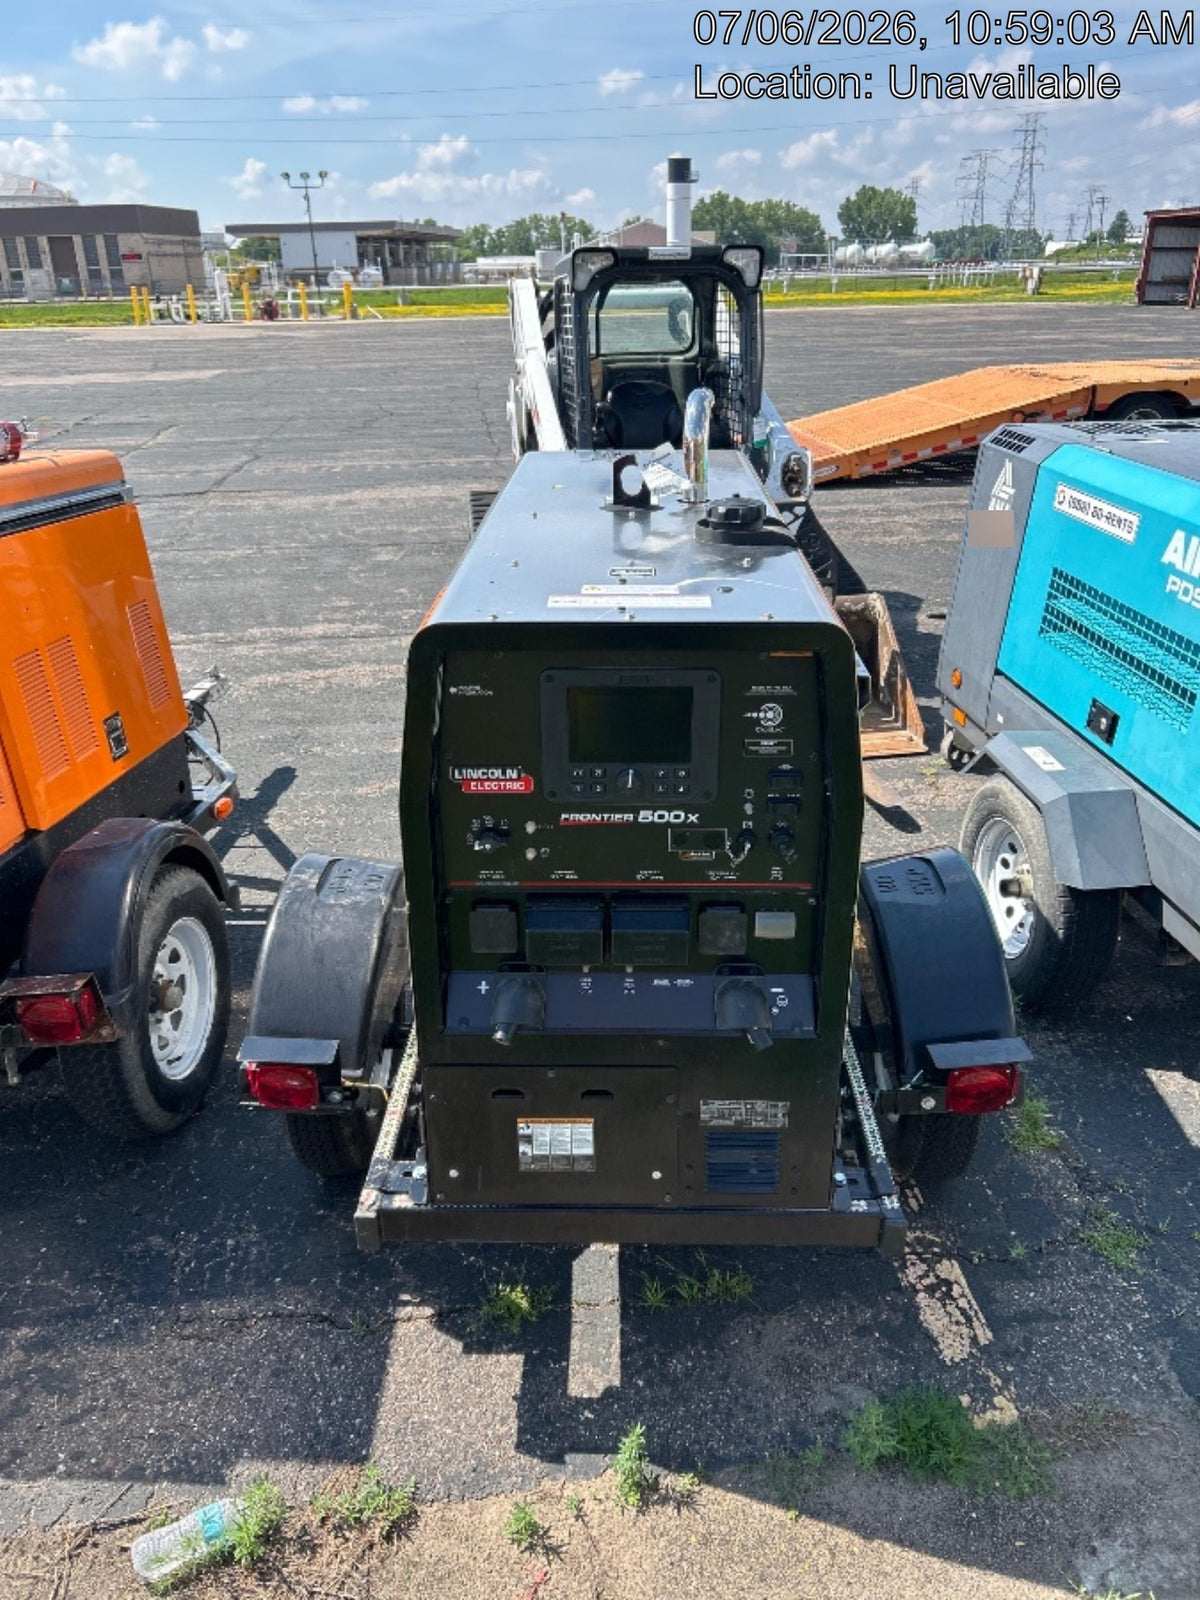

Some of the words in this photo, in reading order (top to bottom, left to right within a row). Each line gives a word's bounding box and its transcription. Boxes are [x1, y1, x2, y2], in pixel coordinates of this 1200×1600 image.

[454, 768, 518, 779] LINCOLN
[470, 781, 525, 790] ELECTRIC
[560, 813, 634, 822] FRONTIER
